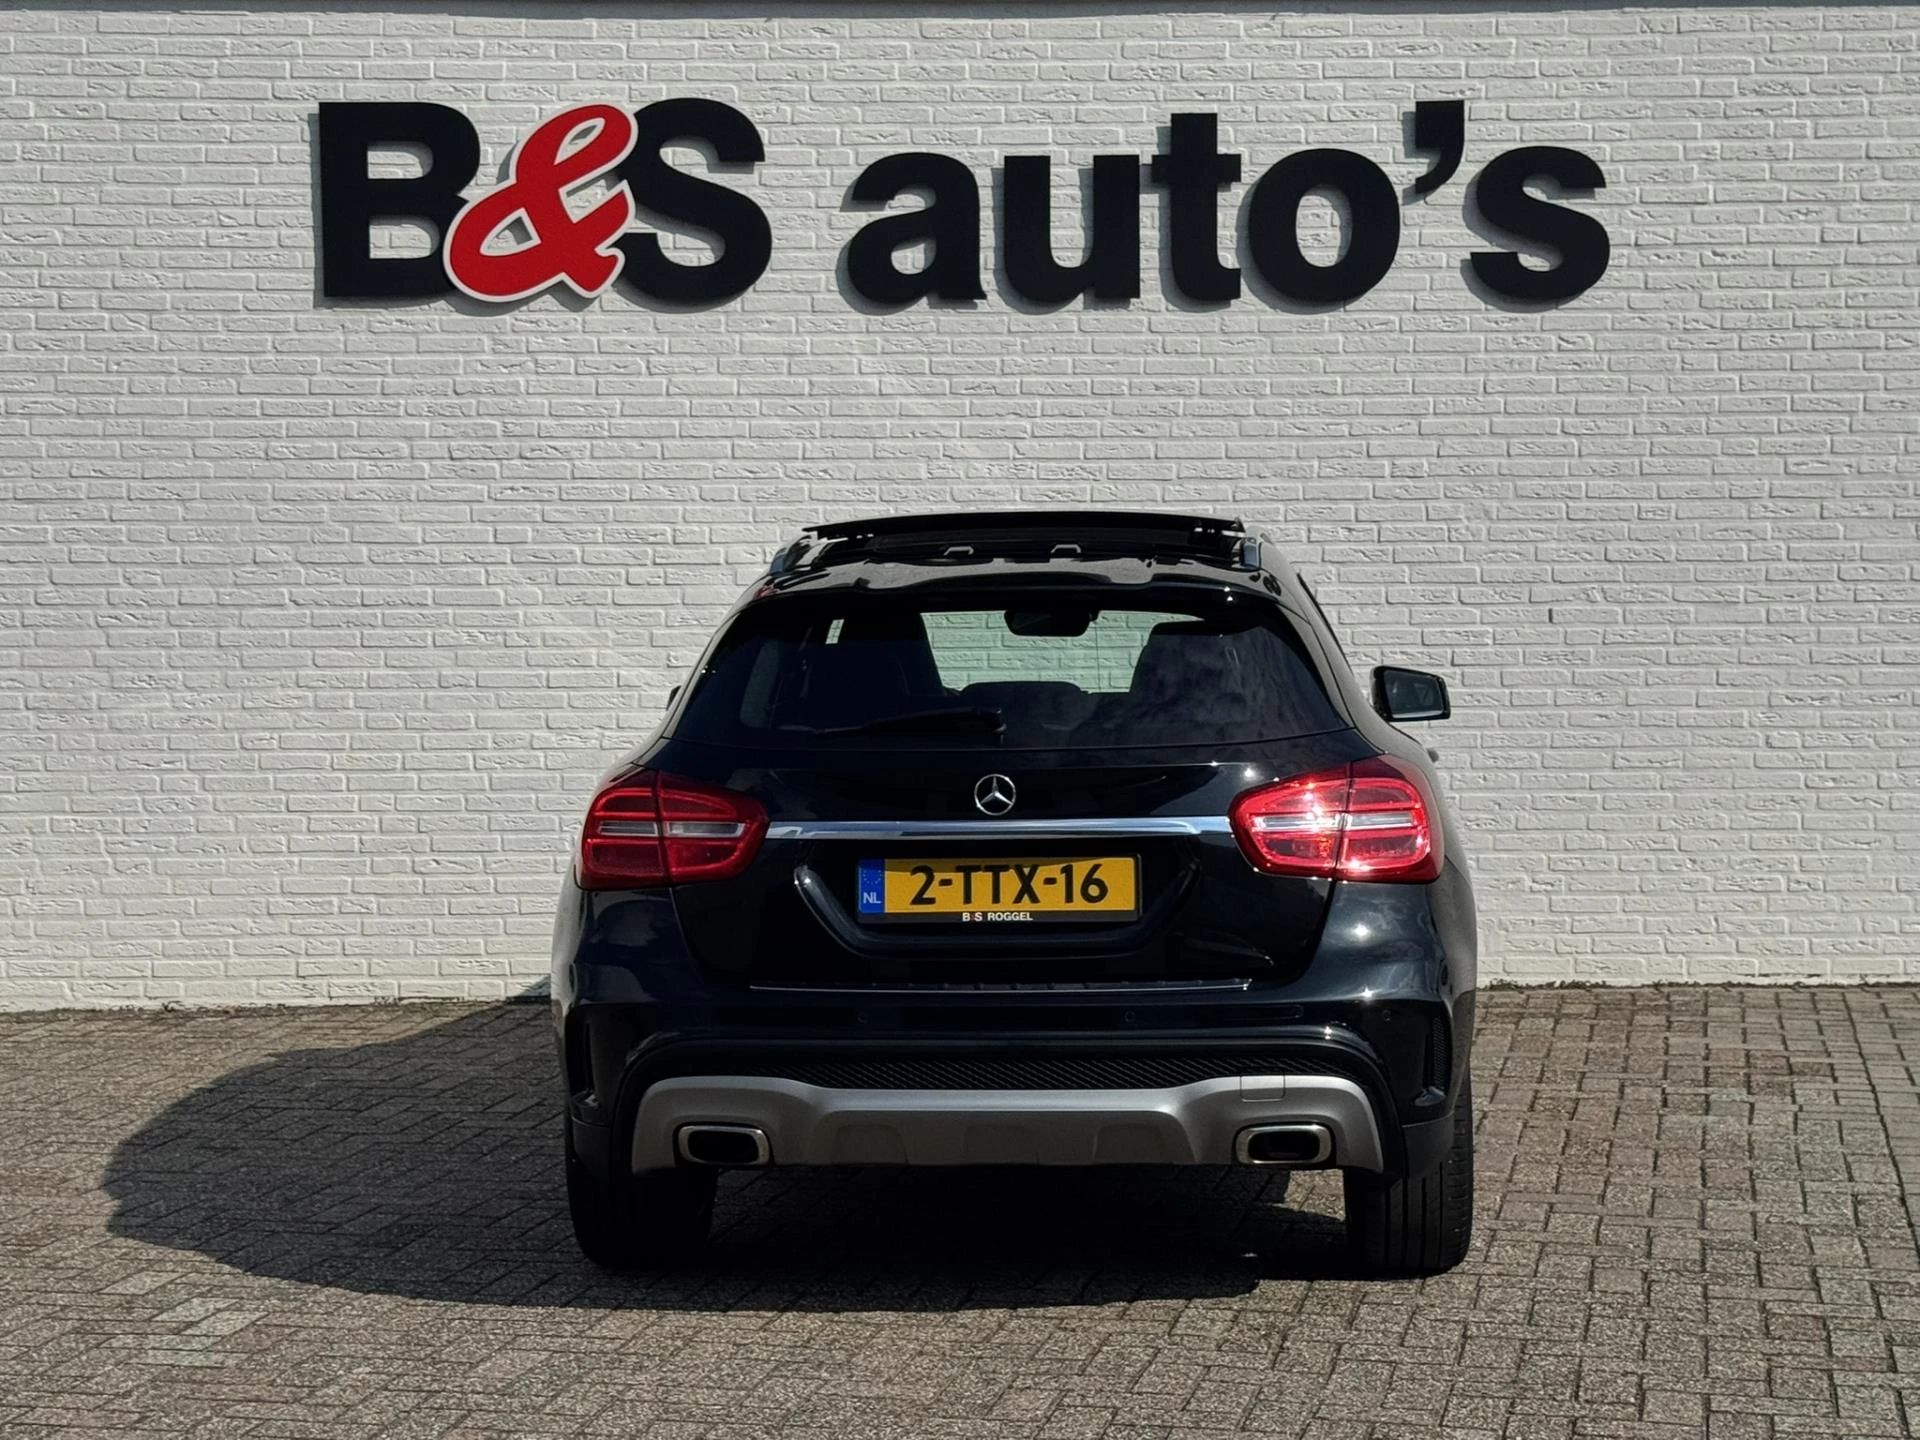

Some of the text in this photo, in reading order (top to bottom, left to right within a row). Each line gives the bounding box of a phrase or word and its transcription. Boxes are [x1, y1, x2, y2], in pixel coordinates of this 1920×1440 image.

[318, 98, 1610, 306] B&S auto's
[862, 891, 882, 904] NL
[909, 863, 1109, 906] 2-TTX-16
[962, 911, 1033, 922] BS ROGGEL
